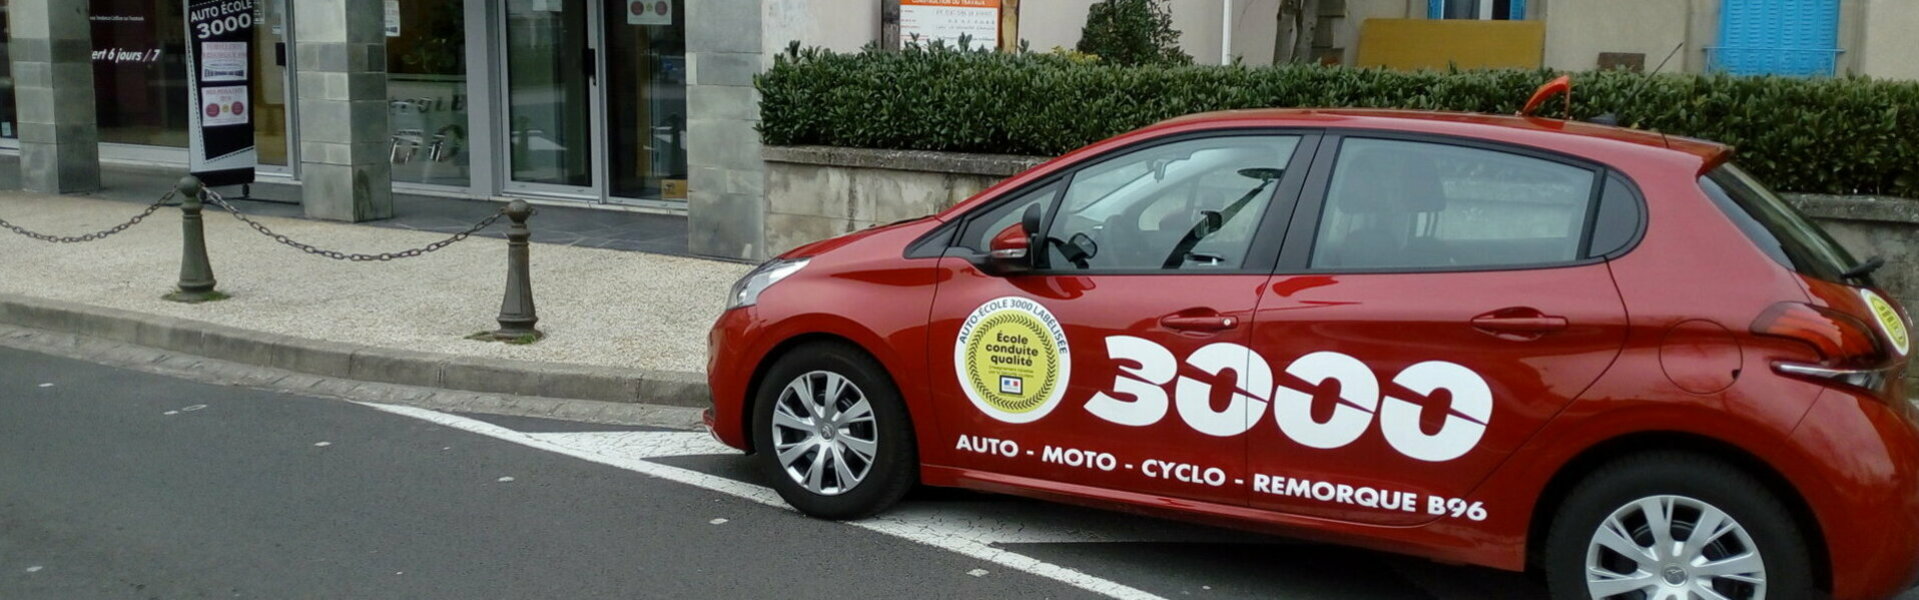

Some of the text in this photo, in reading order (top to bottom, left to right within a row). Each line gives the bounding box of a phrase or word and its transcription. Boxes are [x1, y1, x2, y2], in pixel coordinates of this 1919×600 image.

[190, 6, 219, 22] AUTO
[220, 0, 253, 15] ÉCOLE
[196, 13, 251, 39] 3000
[107, 47, 116, 60] 6
[115, 47, 142, 63] jours
[152, 48, 161, 61] 7
[959, 299, 1008, 344] AUTO-ÉCOLE
[1010, 298, 1033, 312] 3000
[996, 330, 1029, 345] École
[985, 343, 1039, 357] conduite
[990, 354, 1033, 367] qualité
[1084, 335, 1494, 462] 3000
[956, 434, 1019, 458] AUTO
[1042, 445, 1117, 471] MOTO
[1141, 458, 1226, 487] CYCLO
[1253, 473, 1418, 512] REMORQUE
[1427, 495, 1488, 521] B96
